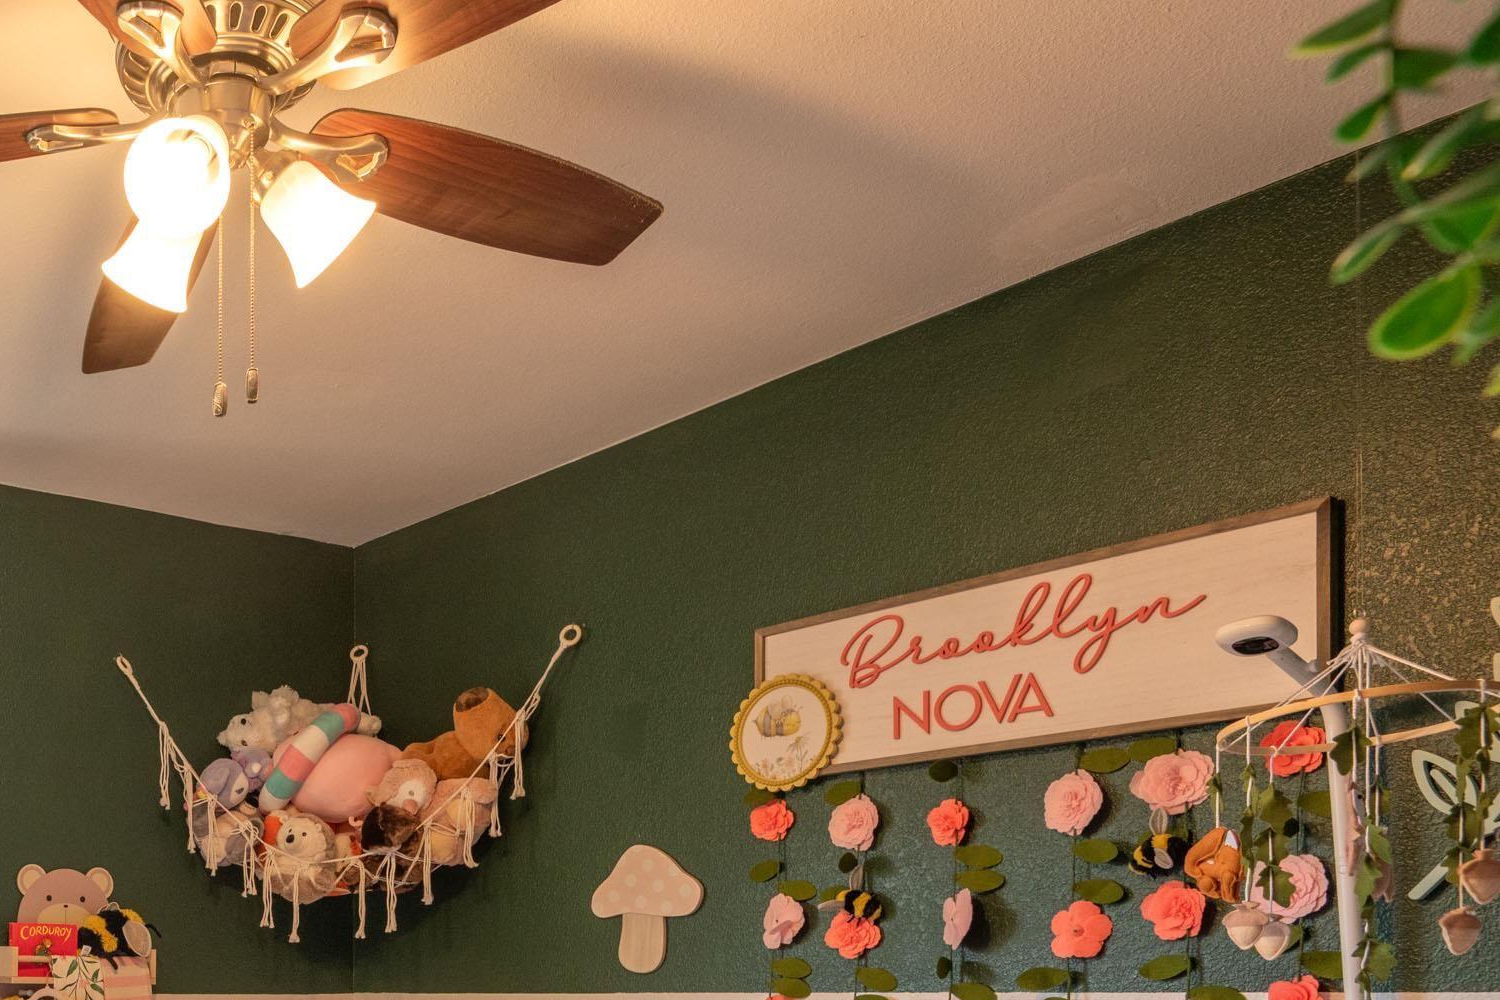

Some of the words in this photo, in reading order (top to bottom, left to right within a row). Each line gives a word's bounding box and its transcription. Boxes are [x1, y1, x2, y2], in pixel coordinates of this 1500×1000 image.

[840, 573, 1208, 689] Brooklyn
[892, 672, 1055, 740] NOVA
[20, 925, 72, 944] CORDUROY
